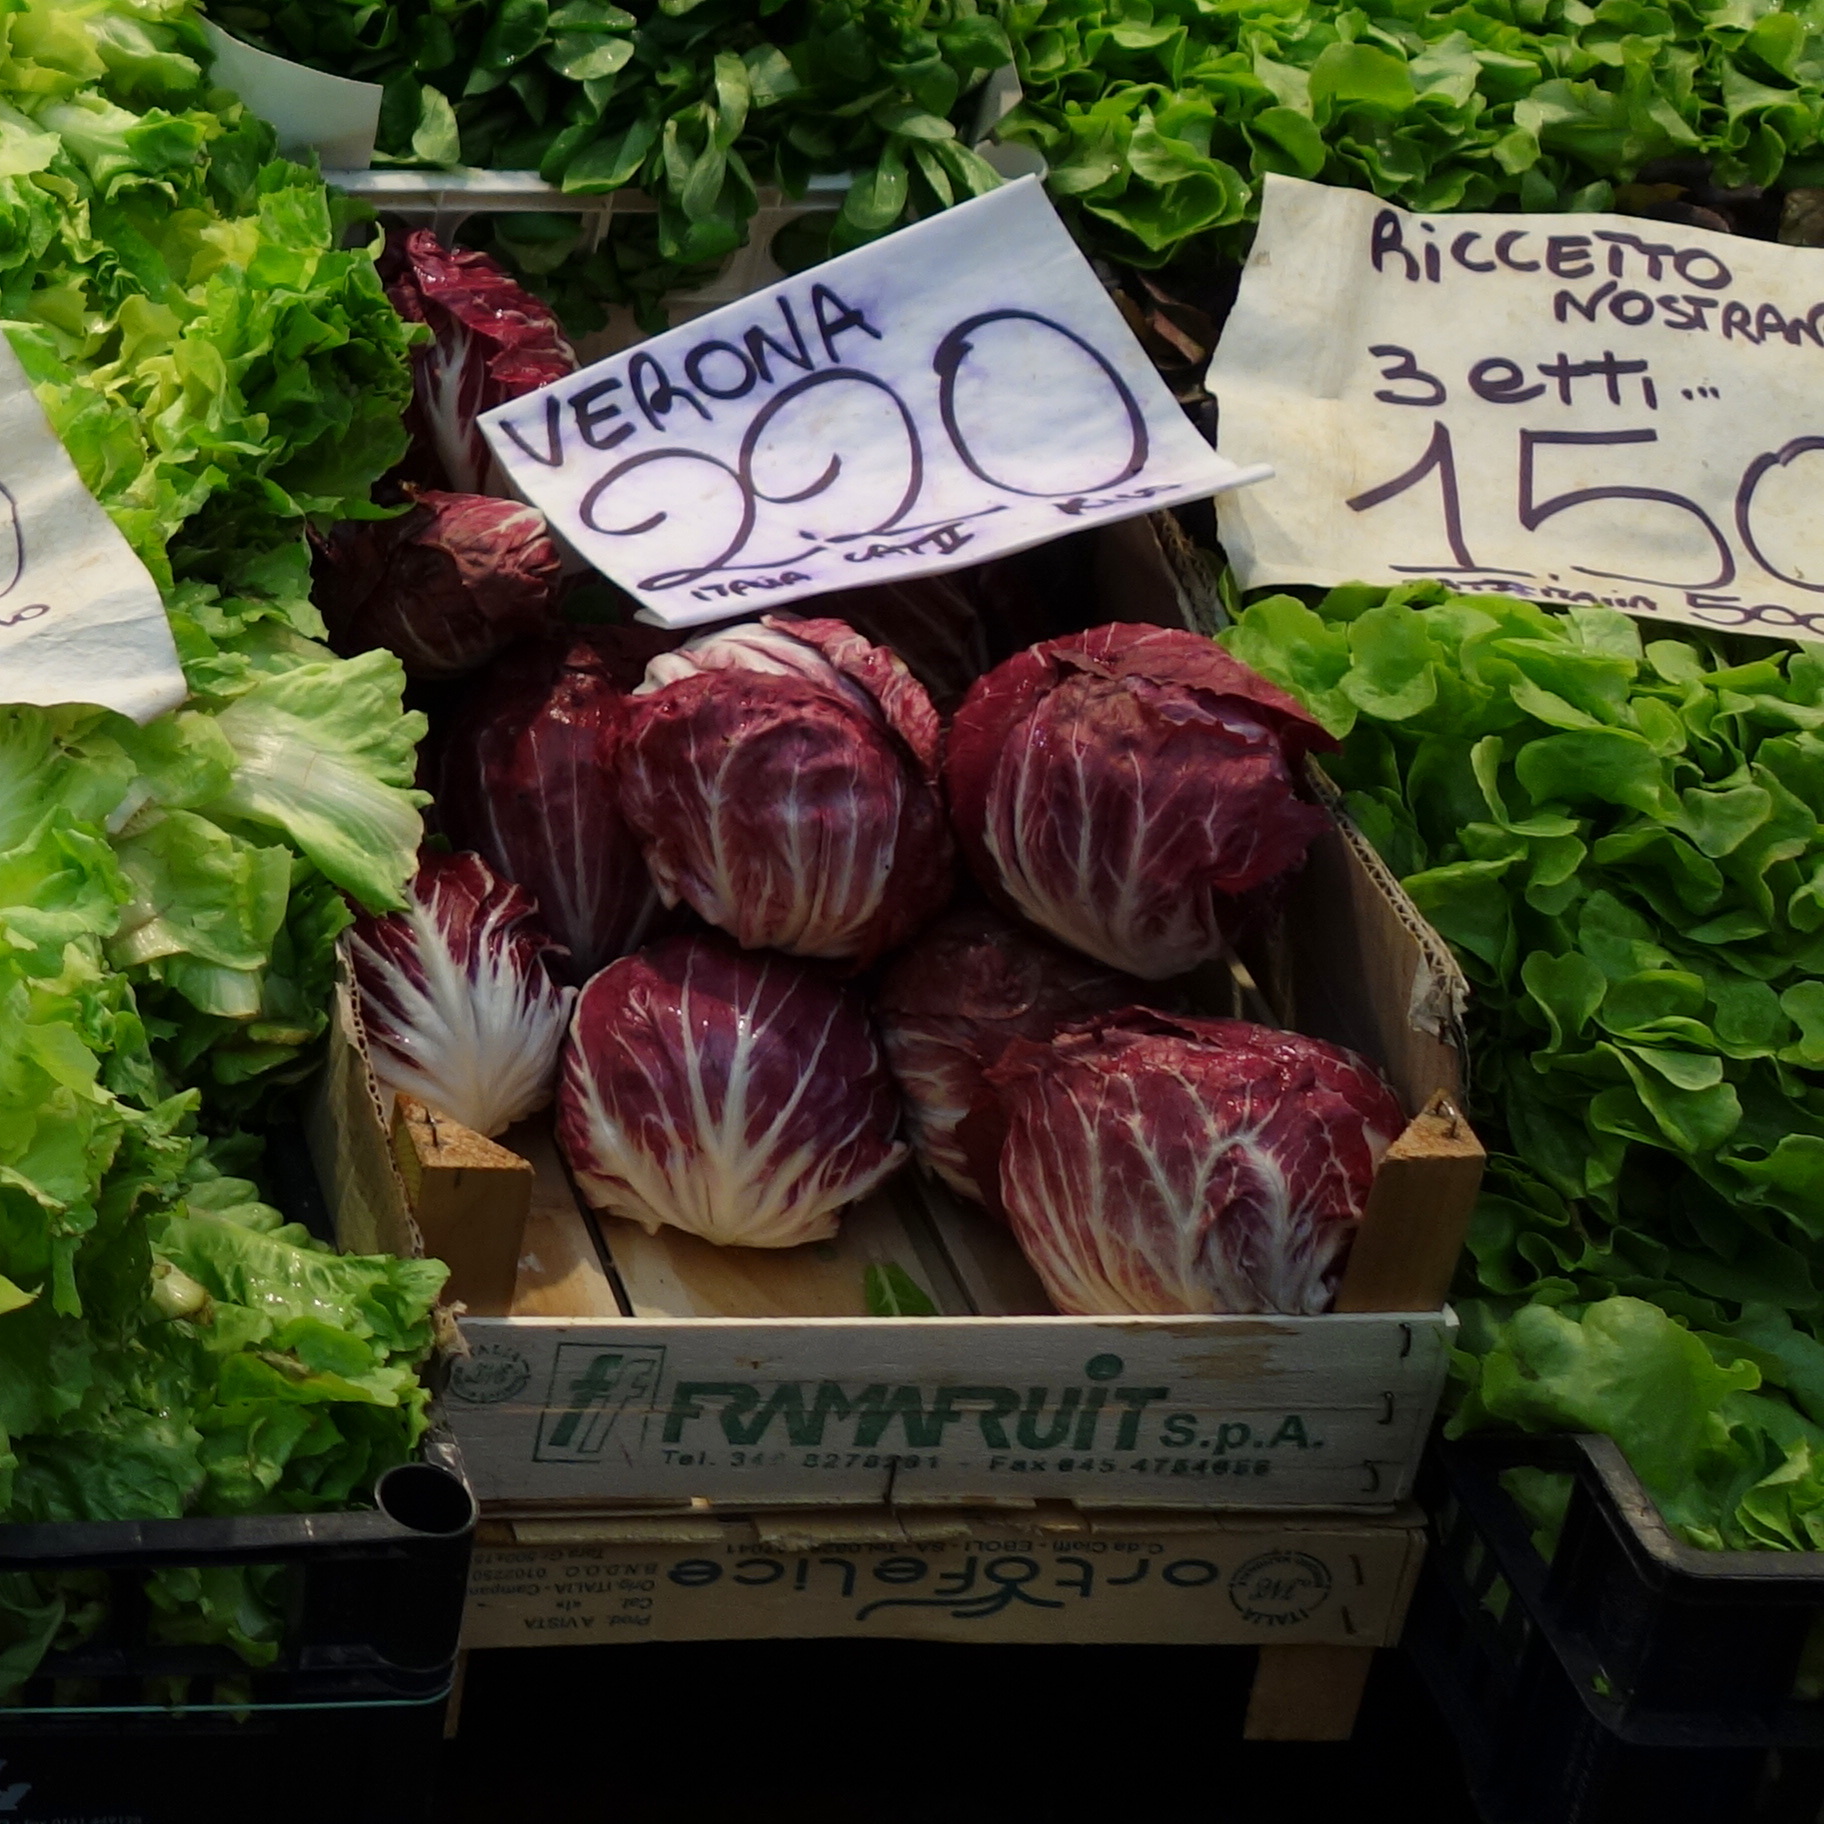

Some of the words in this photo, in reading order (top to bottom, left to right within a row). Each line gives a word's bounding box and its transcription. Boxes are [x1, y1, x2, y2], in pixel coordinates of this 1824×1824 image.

[1370, 208, 1732, 290] RICCETTO
[1554, 279, 1824, 348] NOSTRAN
[499, 282, 882, 470] VERONA
[1368, 344, 1447, 408] 3
[660, 1351, 1169, 1454] FRAMAFRUIT
[1157, 1407, 1327, 1454] S.p.A.
[468, 1582, 541, 1596] Campan
[554, 1581, 613, 1594] ITALIA
